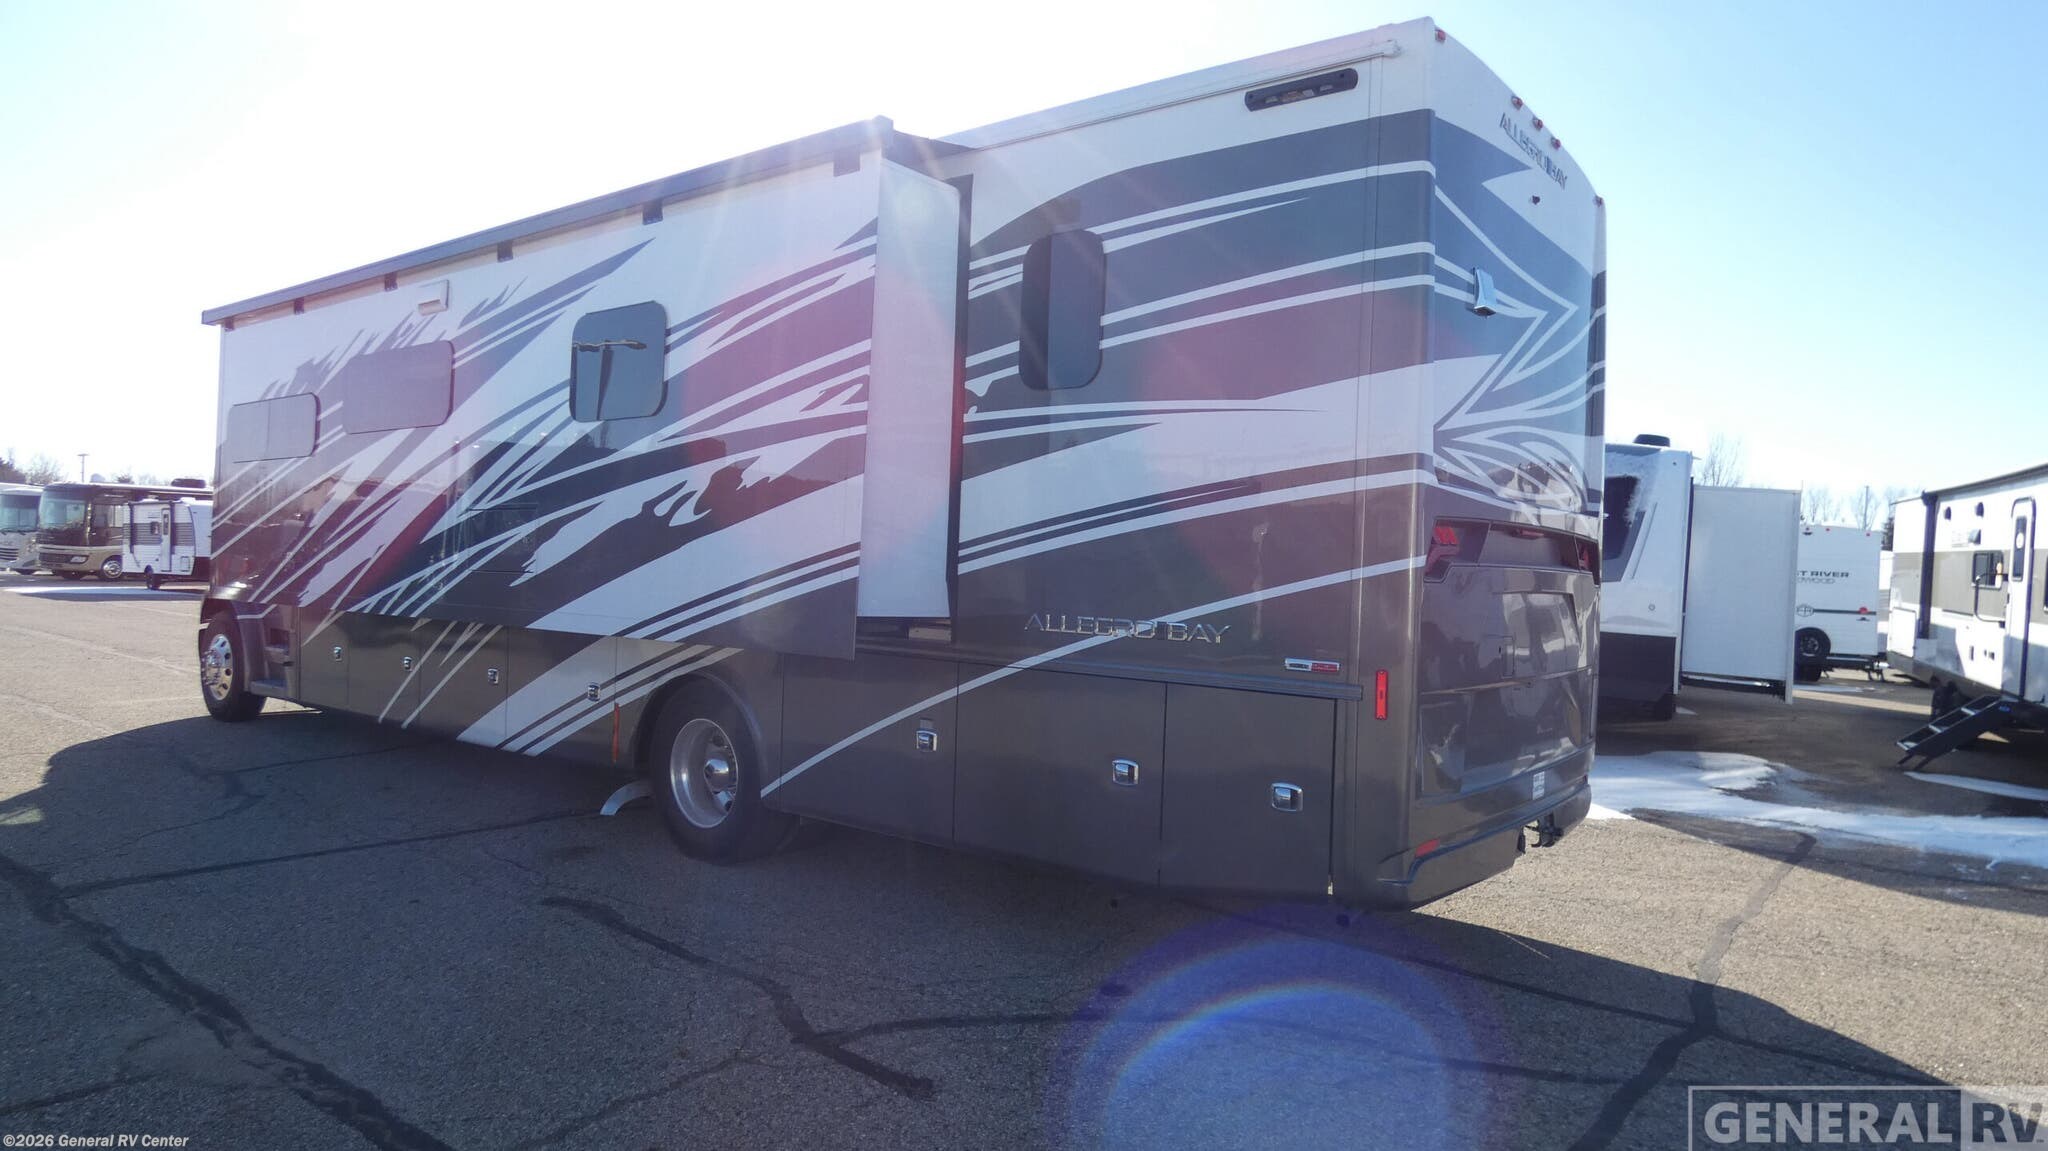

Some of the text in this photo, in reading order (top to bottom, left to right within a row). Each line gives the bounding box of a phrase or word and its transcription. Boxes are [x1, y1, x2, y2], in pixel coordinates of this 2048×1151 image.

[1810, 570, 1849, 578] RIVER
[1024, 613, 1232, 644] ALLEGRO BAY
